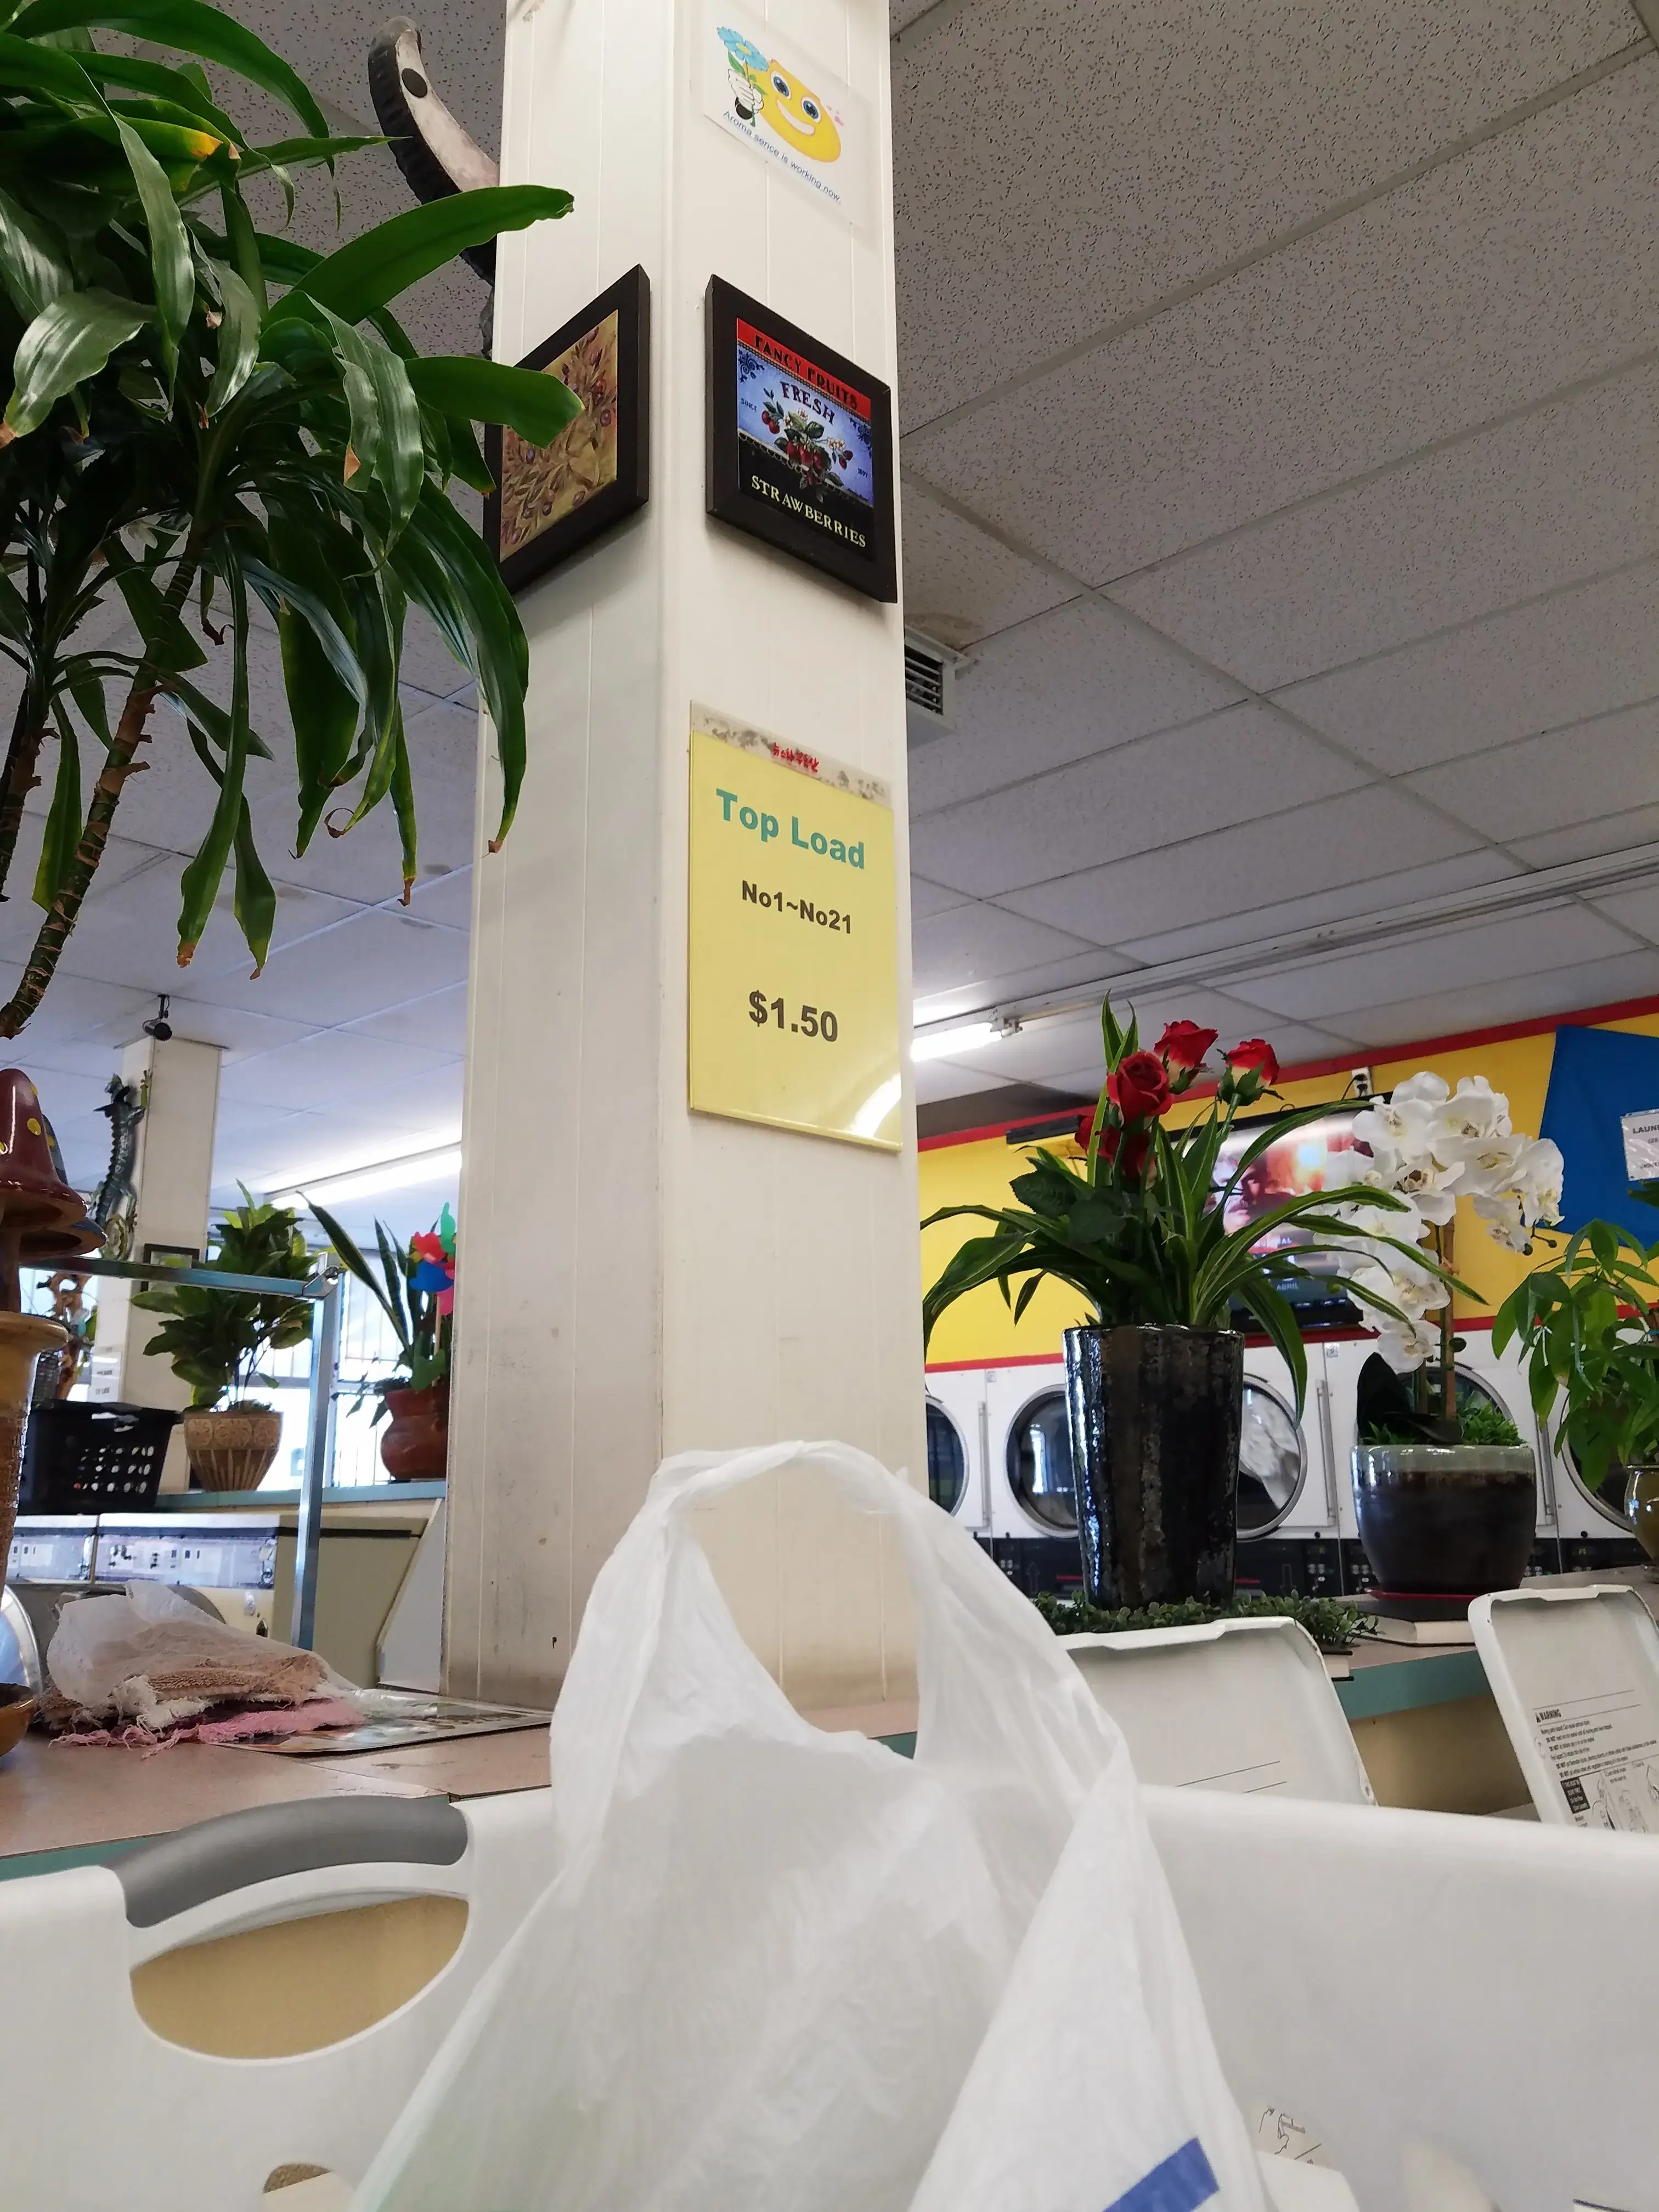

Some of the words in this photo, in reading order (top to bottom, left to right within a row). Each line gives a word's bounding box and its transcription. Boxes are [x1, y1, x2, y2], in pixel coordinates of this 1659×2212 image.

[723, 111, 752, 137] Aroma
[781, 153, 788, 163] is
[791, 161, 822, 189] working
[755, 335, 802, 374] FANCY
[808, 366, 857, 410] FRUITS
[780, 381, 835, 425] FRESH
[741, 398, 757, 412] SINCE
[752, 475, 866, 548] STRAWBERRIES
[716, 789, 779, 842] Top
[792, 817, 865, 869] Load
[742, 879, 851, 934] No1~No21
[748, 989, 838, 1043] $1.50
